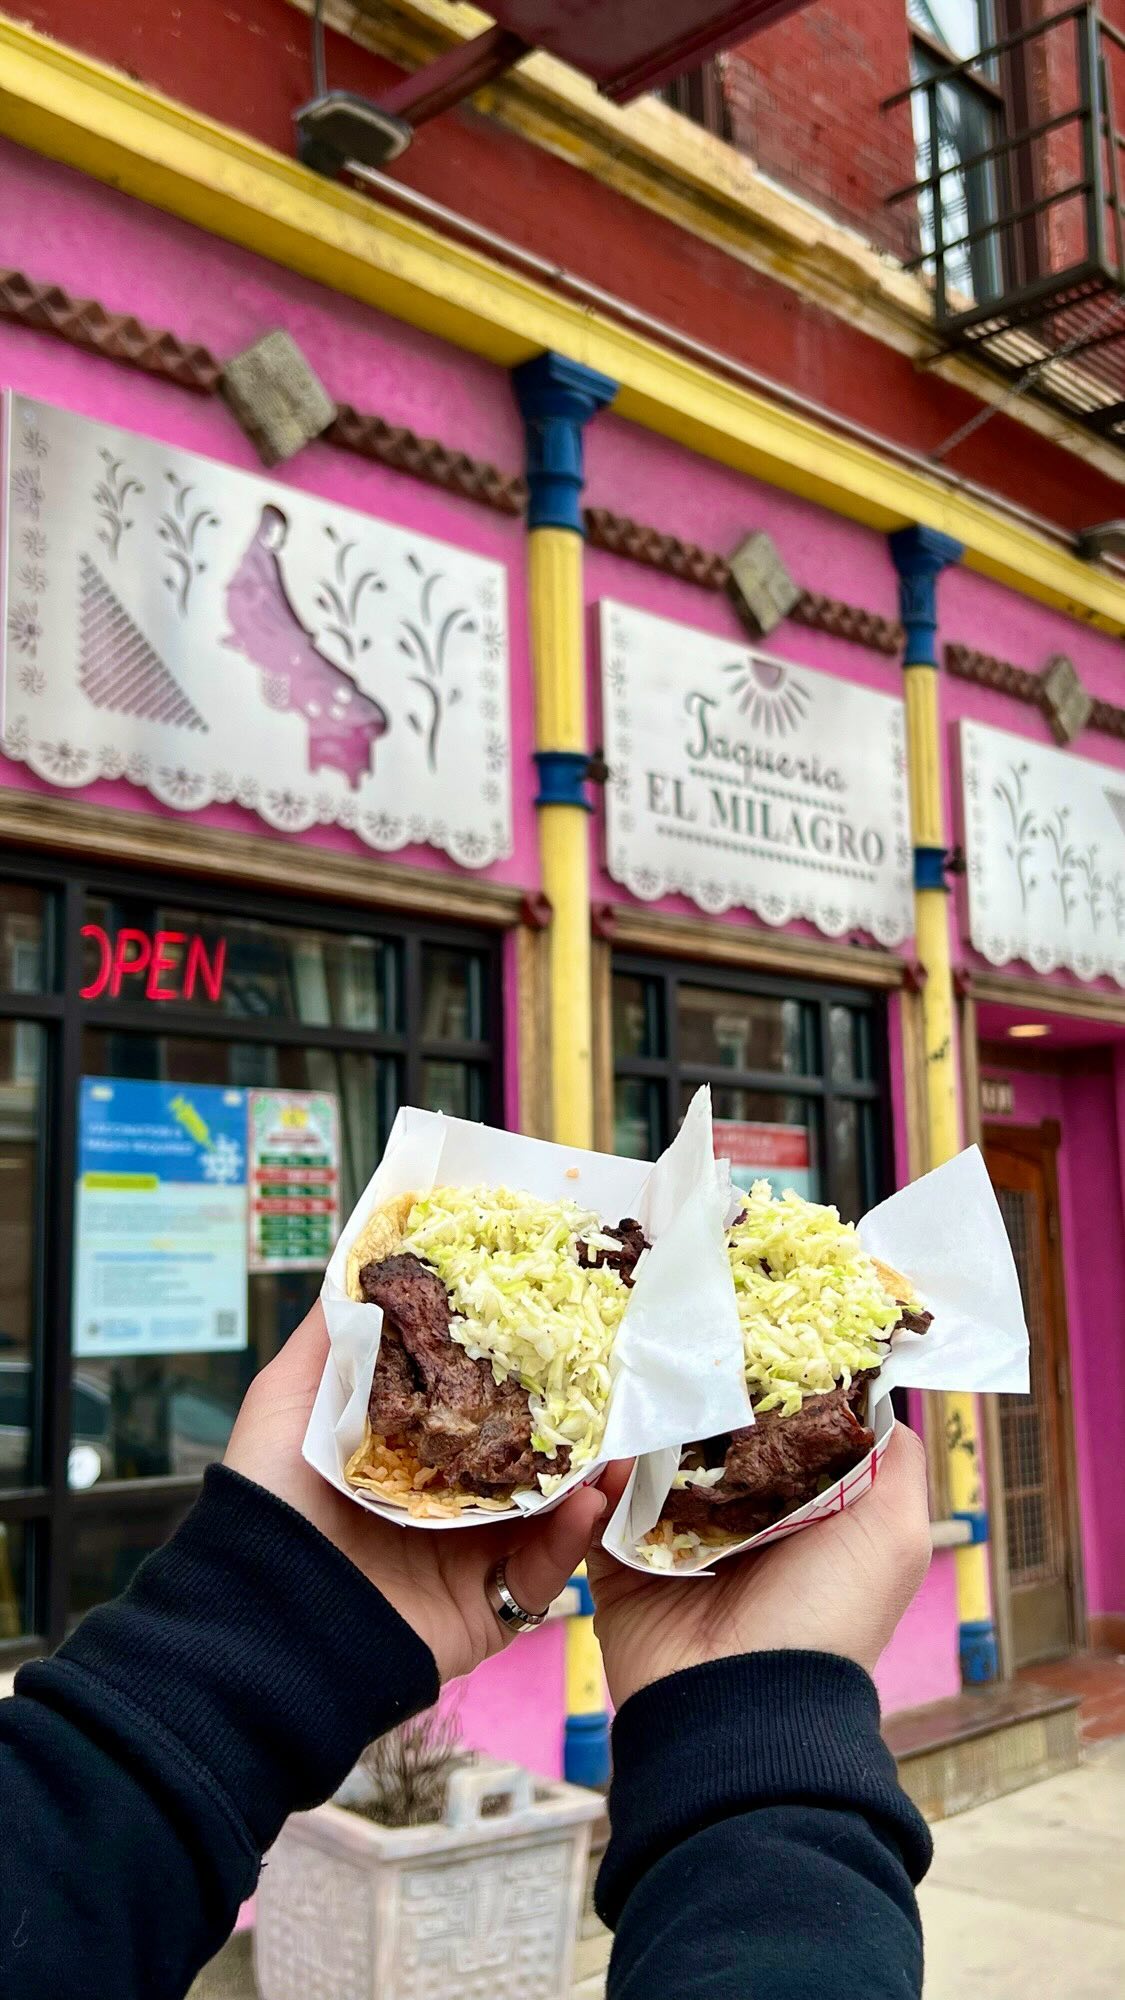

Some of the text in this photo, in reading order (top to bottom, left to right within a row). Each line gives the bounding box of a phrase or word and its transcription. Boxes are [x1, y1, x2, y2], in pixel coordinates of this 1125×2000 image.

[685, 692, 848, 790] Taqueria
[646, 773, 885, 866] EL MILAGRO
